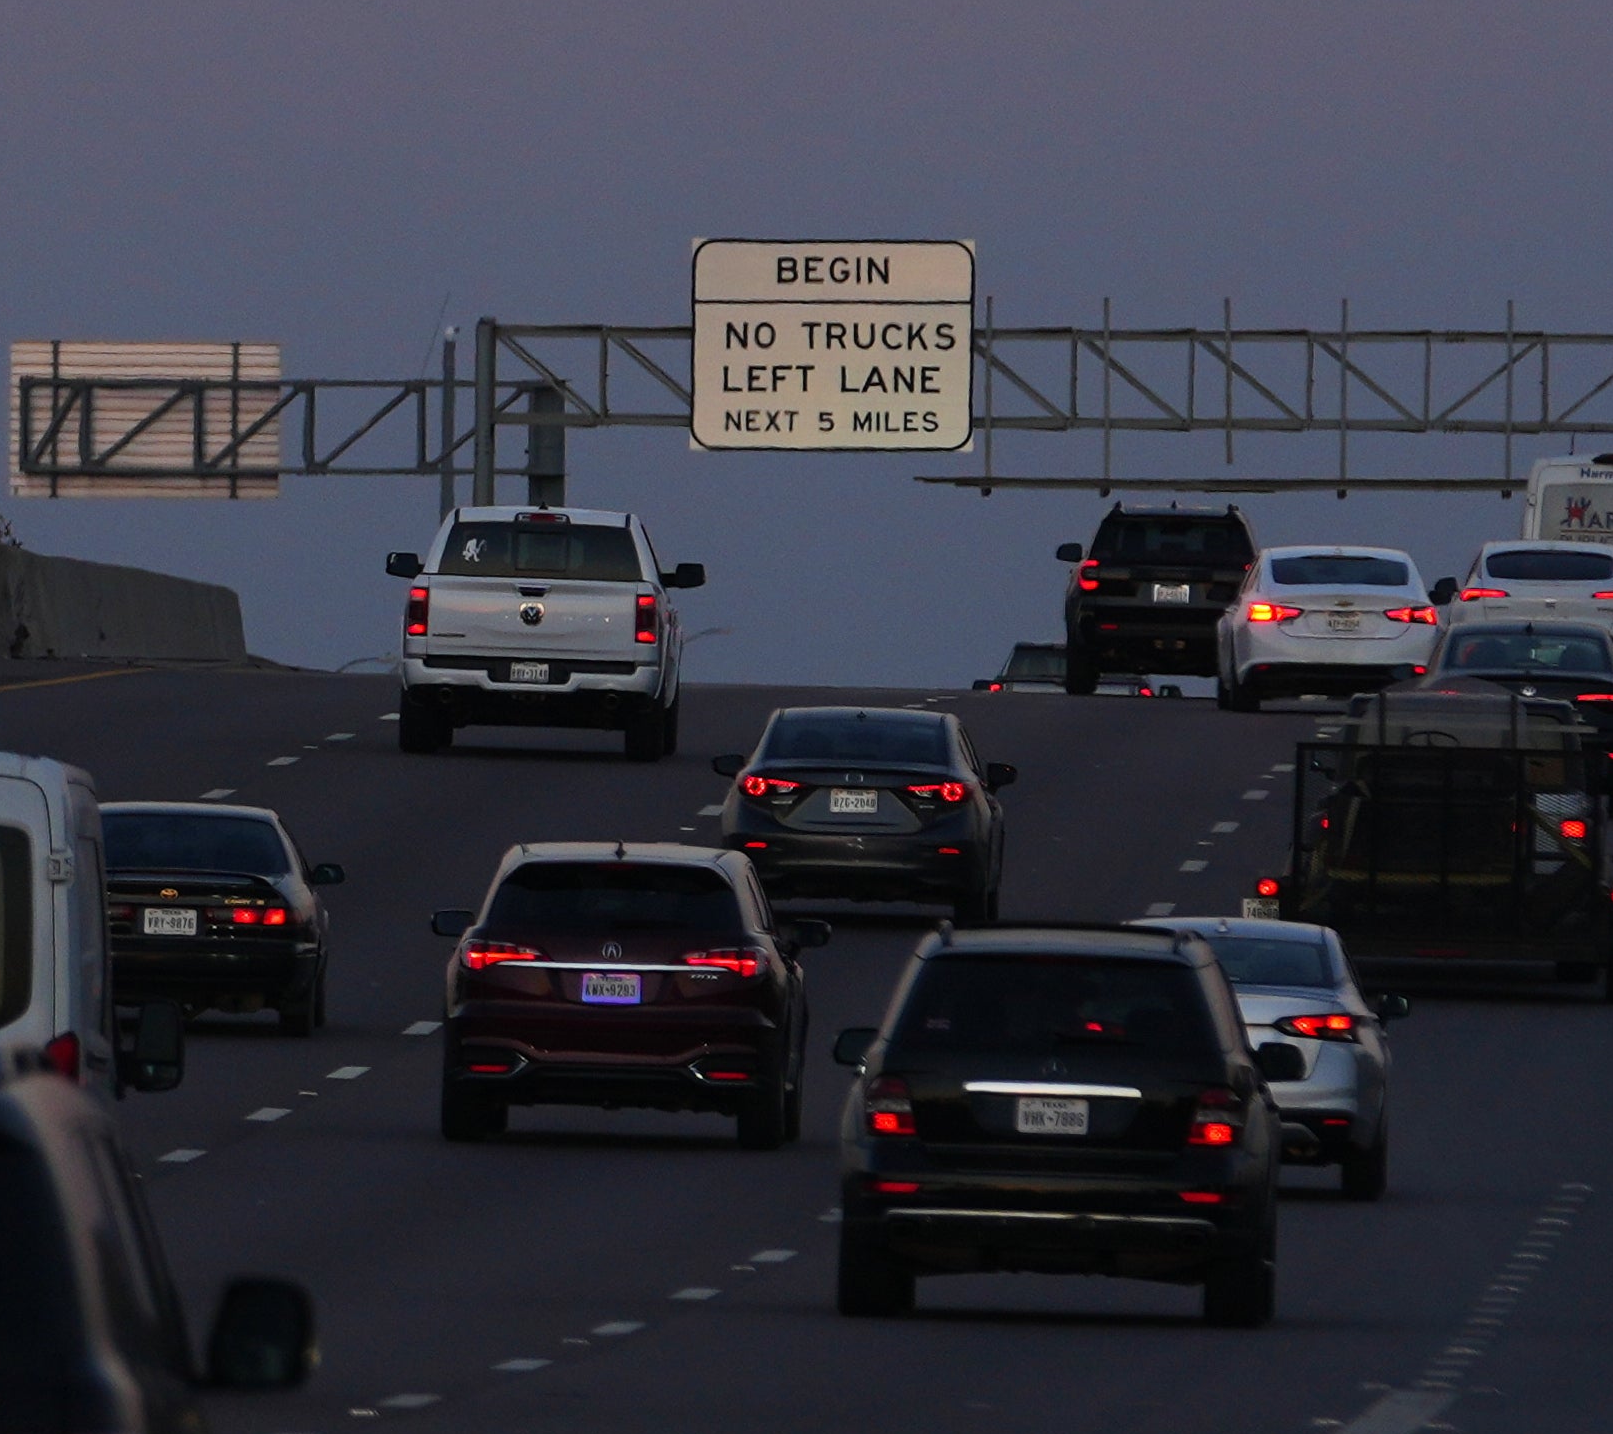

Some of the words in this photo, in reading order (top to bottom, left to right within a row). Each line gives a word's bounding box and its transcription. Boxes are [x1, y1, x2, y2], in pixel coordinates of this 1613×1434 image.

[776, 256, 890, 284] BEGIN
[725, 322, 774, 350] NO
[802, 322, 956, 350] TRUCKS
[722, 366, 815, 392] LEFT
[840, 366, 941, 393] LANE
[724, 410, 799, 432] NEXT
[818, 411, 835, 432] 5
[852, 411, 939, 433] MILES
